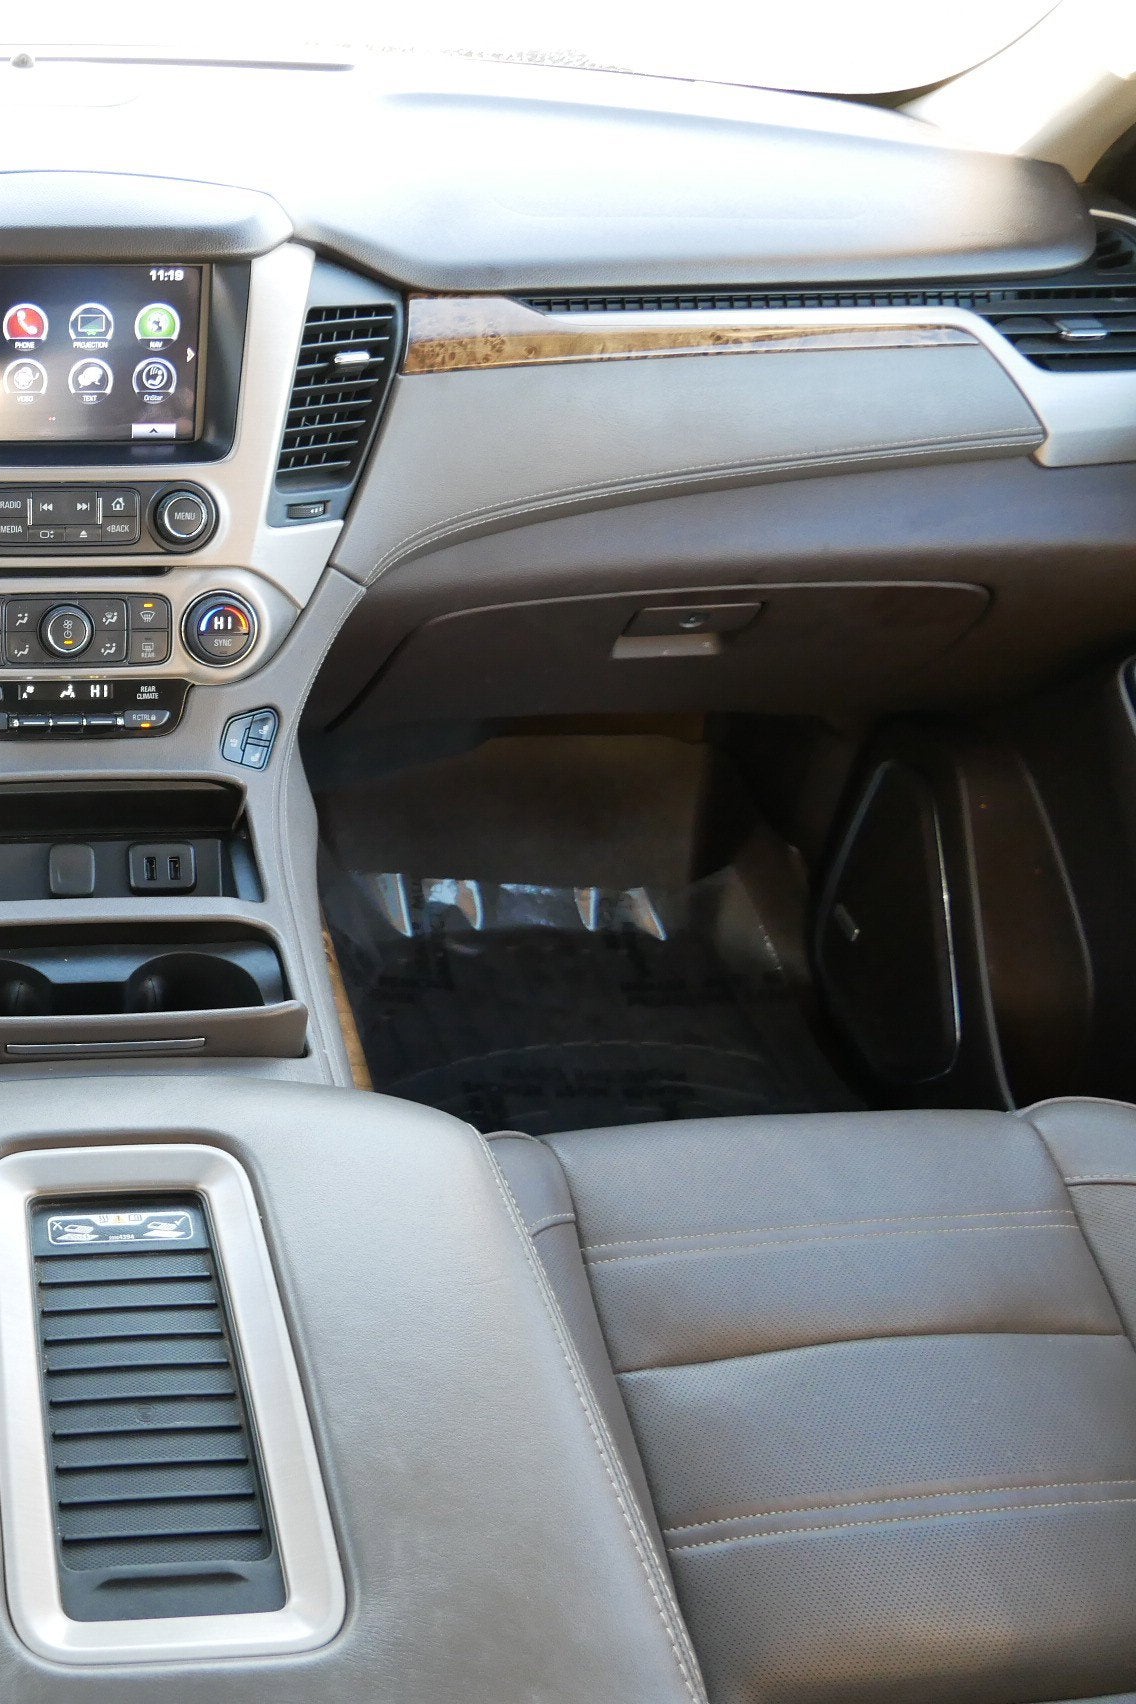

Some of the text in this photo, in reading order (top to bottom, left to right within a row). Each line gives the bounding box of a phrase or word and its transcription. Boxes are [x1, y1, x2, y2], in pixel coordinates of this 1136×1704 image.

[14, 341, 36, 349] PHONE
[72, 341, 109, 349] PROJECTION
[150, 341, 164, 349] NAV
[16, 395, 34, 403] VIDEO
[0, 500, 22, 509] RADIO
[174, 512, 196, 521] MENU
[0, 525, 23, 534] MEDIA
[110, 524, 130, 533] BACK
[214, 616, 233, 631] HI
[213, 638, 233, 647] SYNC
[90, 684, 108, 698] HI
[136, 692, 160, 700] CLIMATE
